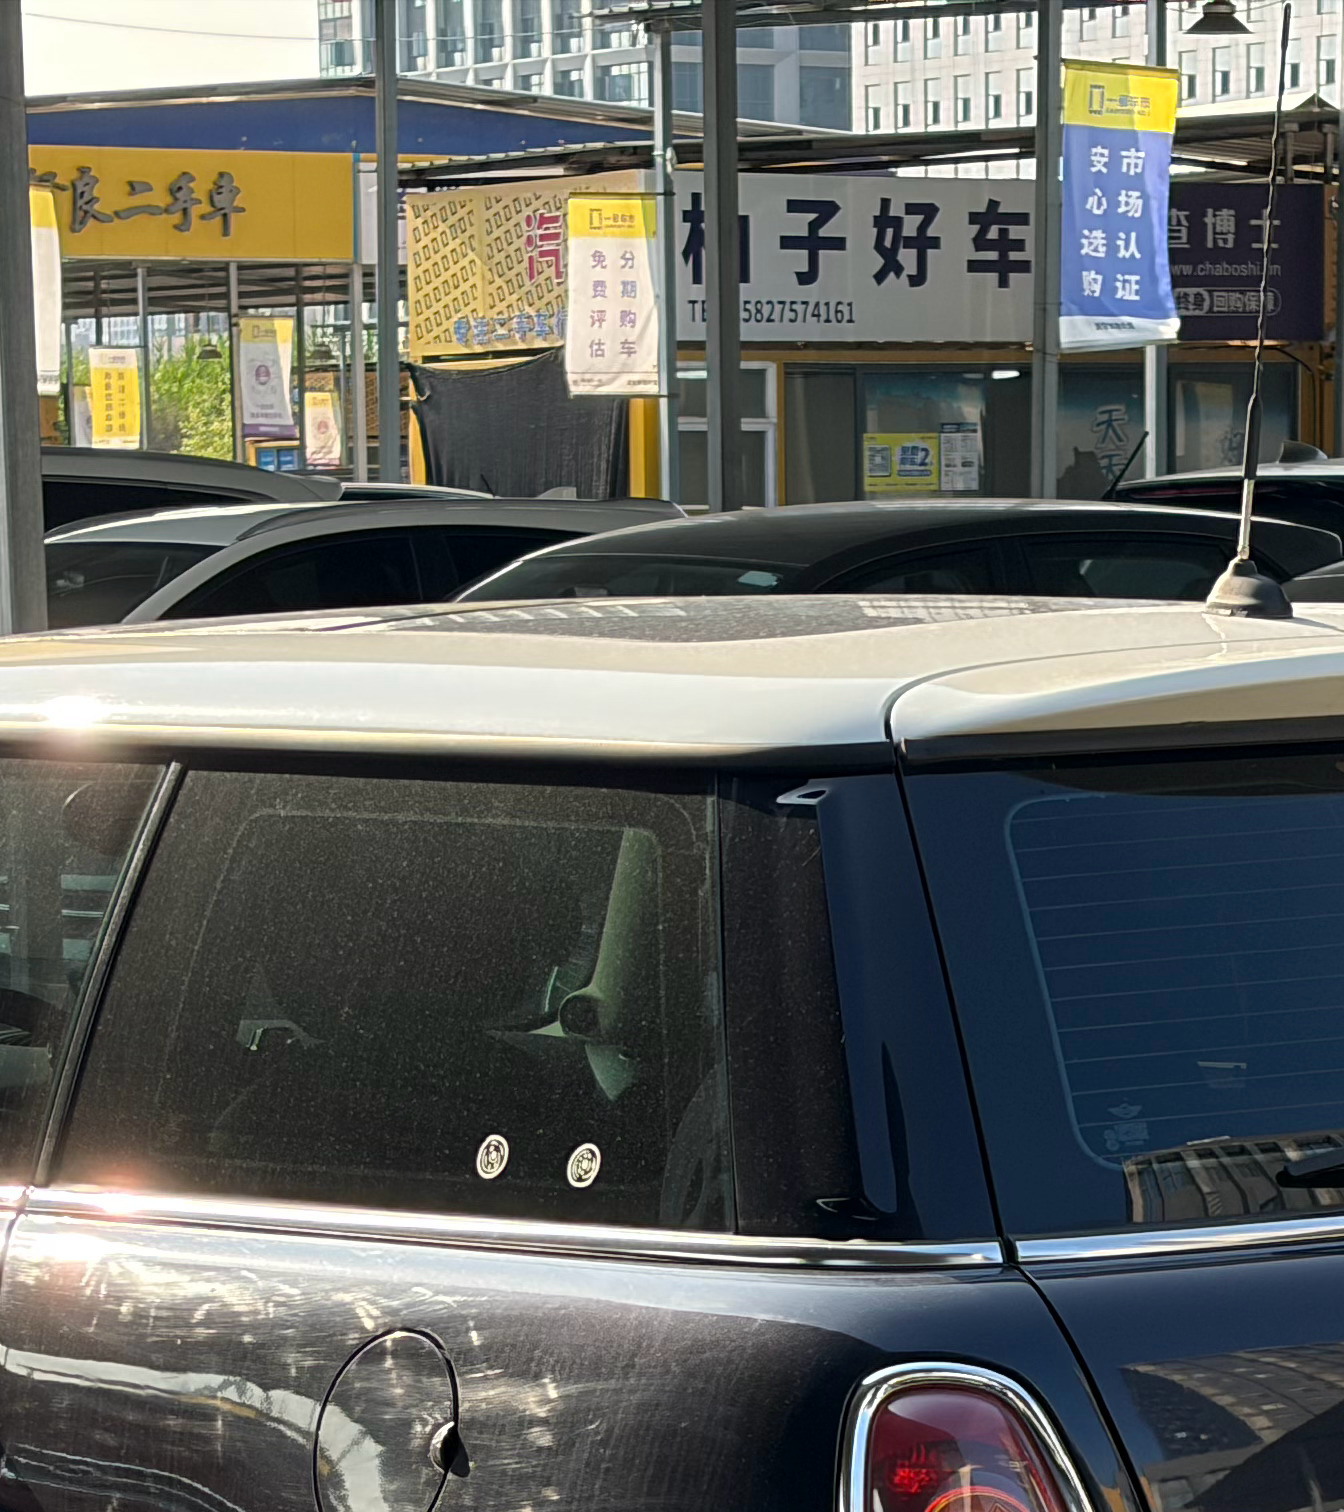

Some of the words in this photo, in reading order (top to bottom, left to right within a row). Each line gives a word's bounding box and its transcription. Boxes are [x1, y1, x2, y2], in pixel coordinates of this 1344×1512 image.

[1080, 145, 1110, 297] 安心选购
[1115, 148, 1145, 301] 市场认证
[589, 250, 608, 359] 免费评估
[619, 250, 638, 358] 分期购车
[742, 300, 855, 324] 5827574161
